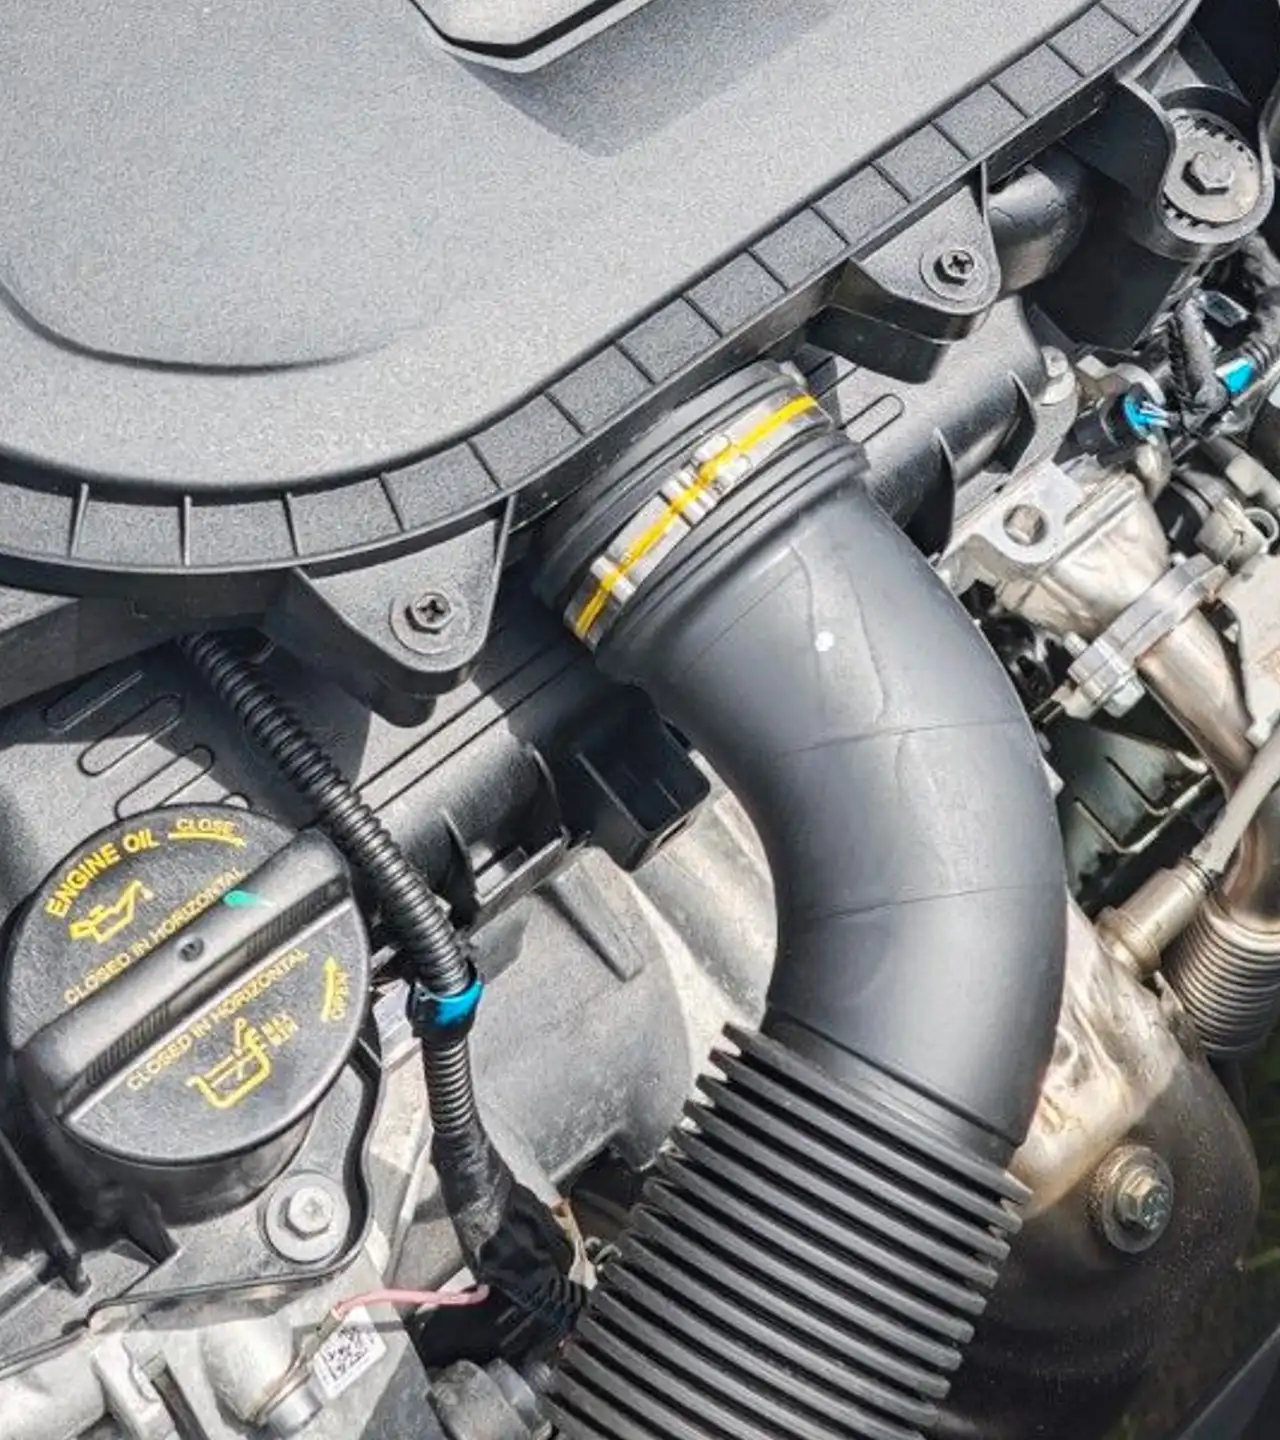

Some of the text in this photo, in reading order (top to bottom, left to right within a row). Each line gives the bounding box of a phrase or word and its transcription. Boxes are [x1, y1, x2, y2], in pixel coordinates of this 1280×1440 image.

[47, 829, 161, 919] ENGINE OIL
[174, 818, 235, 834] CLOSE
[63, 866, 244, 1006] CLOSED IN HORIZONTAL
[126, 947, 310, 1091] CLOSED IN HORIZONTAL
